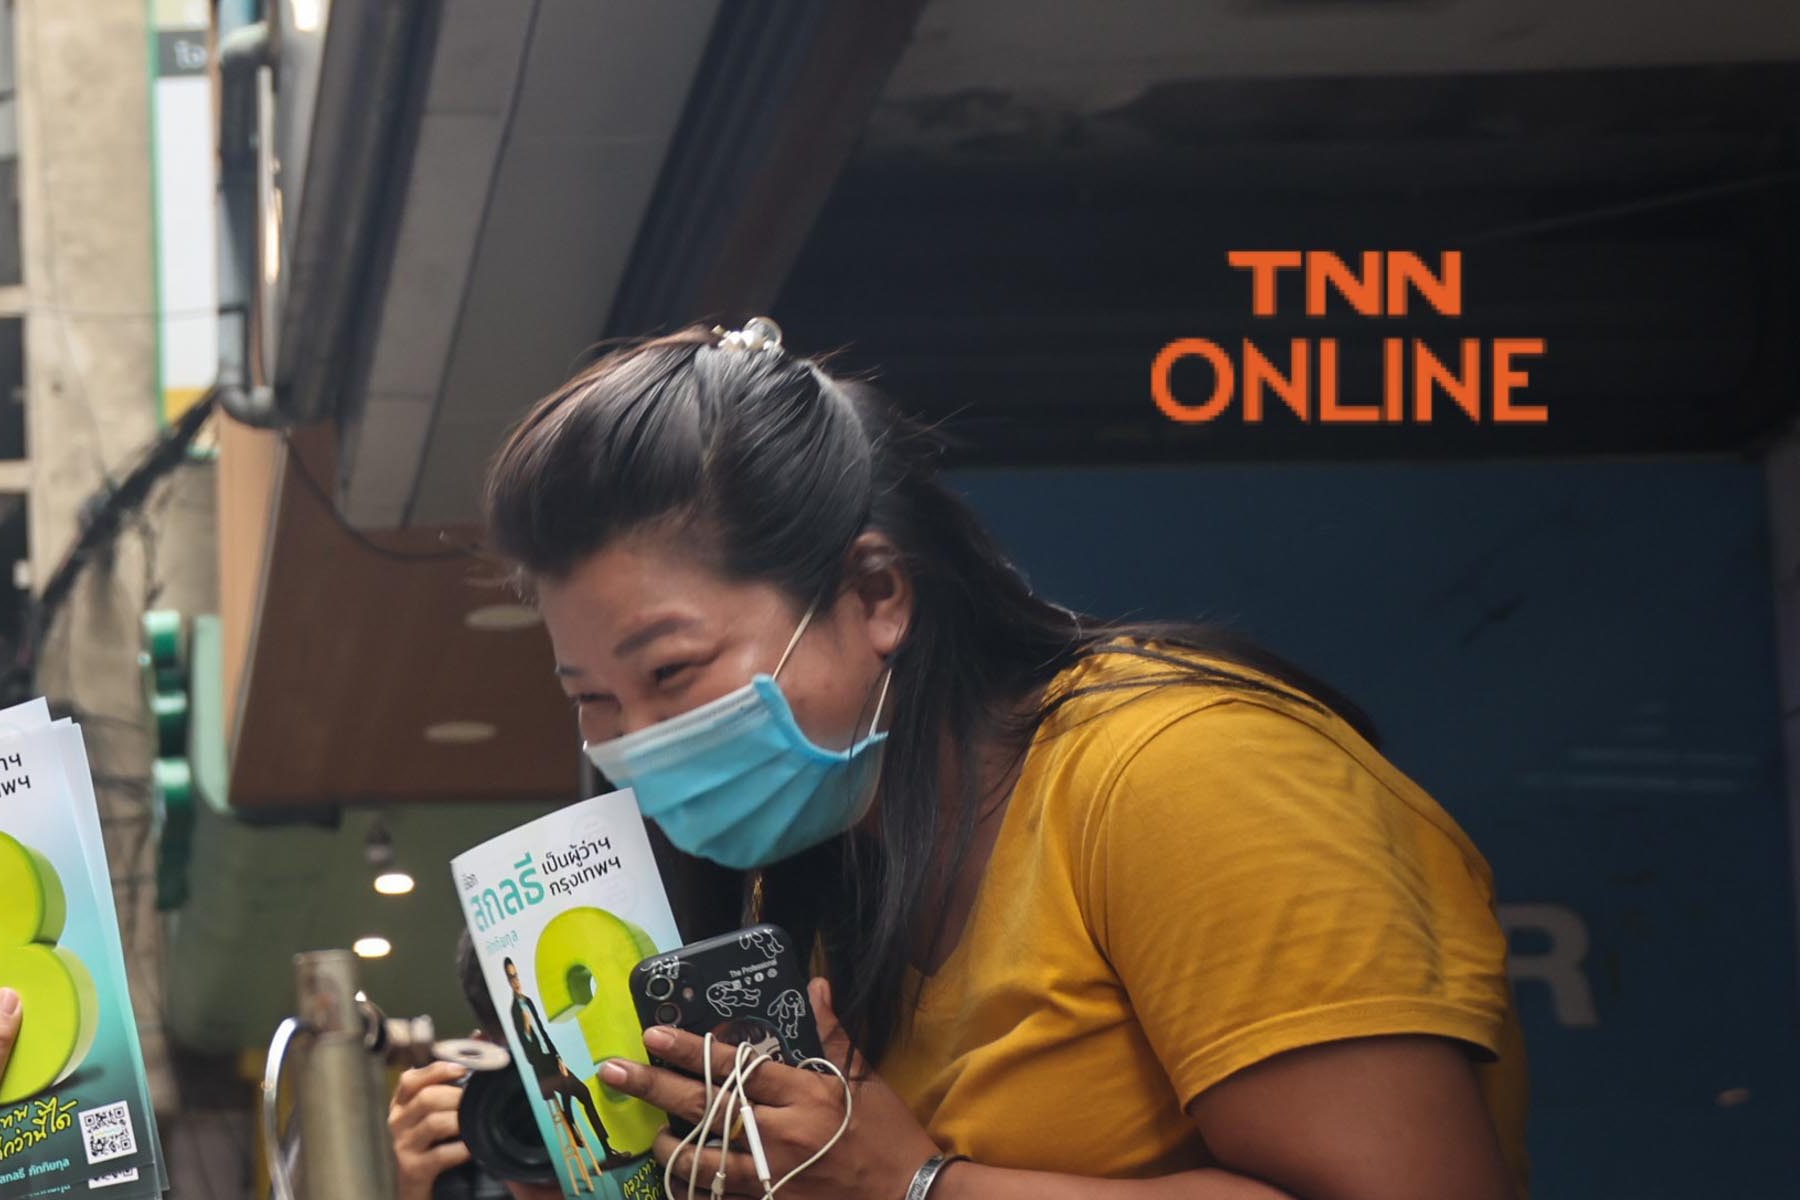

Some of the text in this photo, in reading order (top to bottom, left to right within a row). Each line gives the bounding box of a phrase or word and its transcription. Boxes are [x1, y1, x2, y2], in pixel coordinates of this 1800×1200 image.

[541, 836, 612, 875] เป็นผู้ว่าฯ
[470, 851, 546, 933] สกลธี
[548, 856, 622, 897] กรุงเทพฯ
